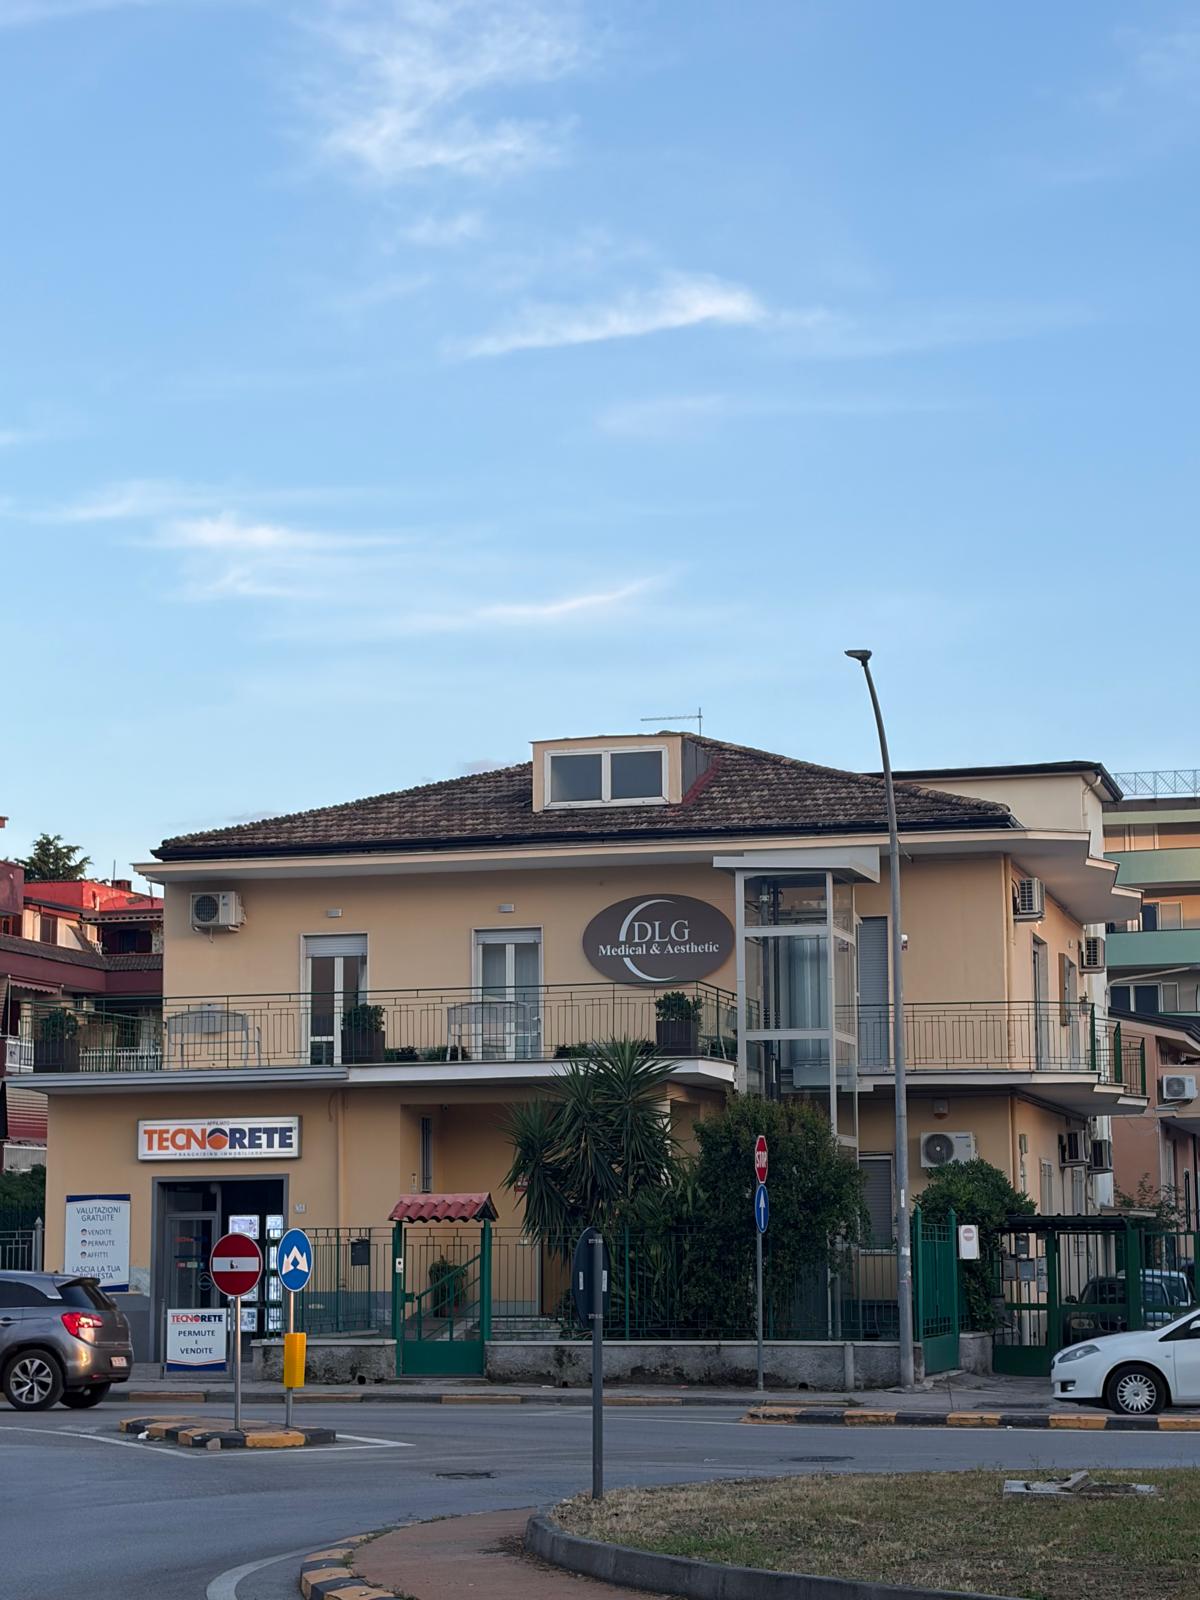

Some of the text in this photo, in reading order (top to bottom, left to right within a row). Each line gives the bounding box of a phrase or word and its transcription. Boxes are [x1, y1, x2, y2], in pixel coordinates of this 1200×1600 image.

[632, 920, 690, 942] DLG
[598, 941, 719, 956] Medical & Aesthetic
[756, 1151, 768, 1168] STOP
[76, 1206, 121, 1214] VALUTAZIONI
[81, 1214, 115, 1222] GRATUITE
[72, 1265, 95, 1273] LASCIA
